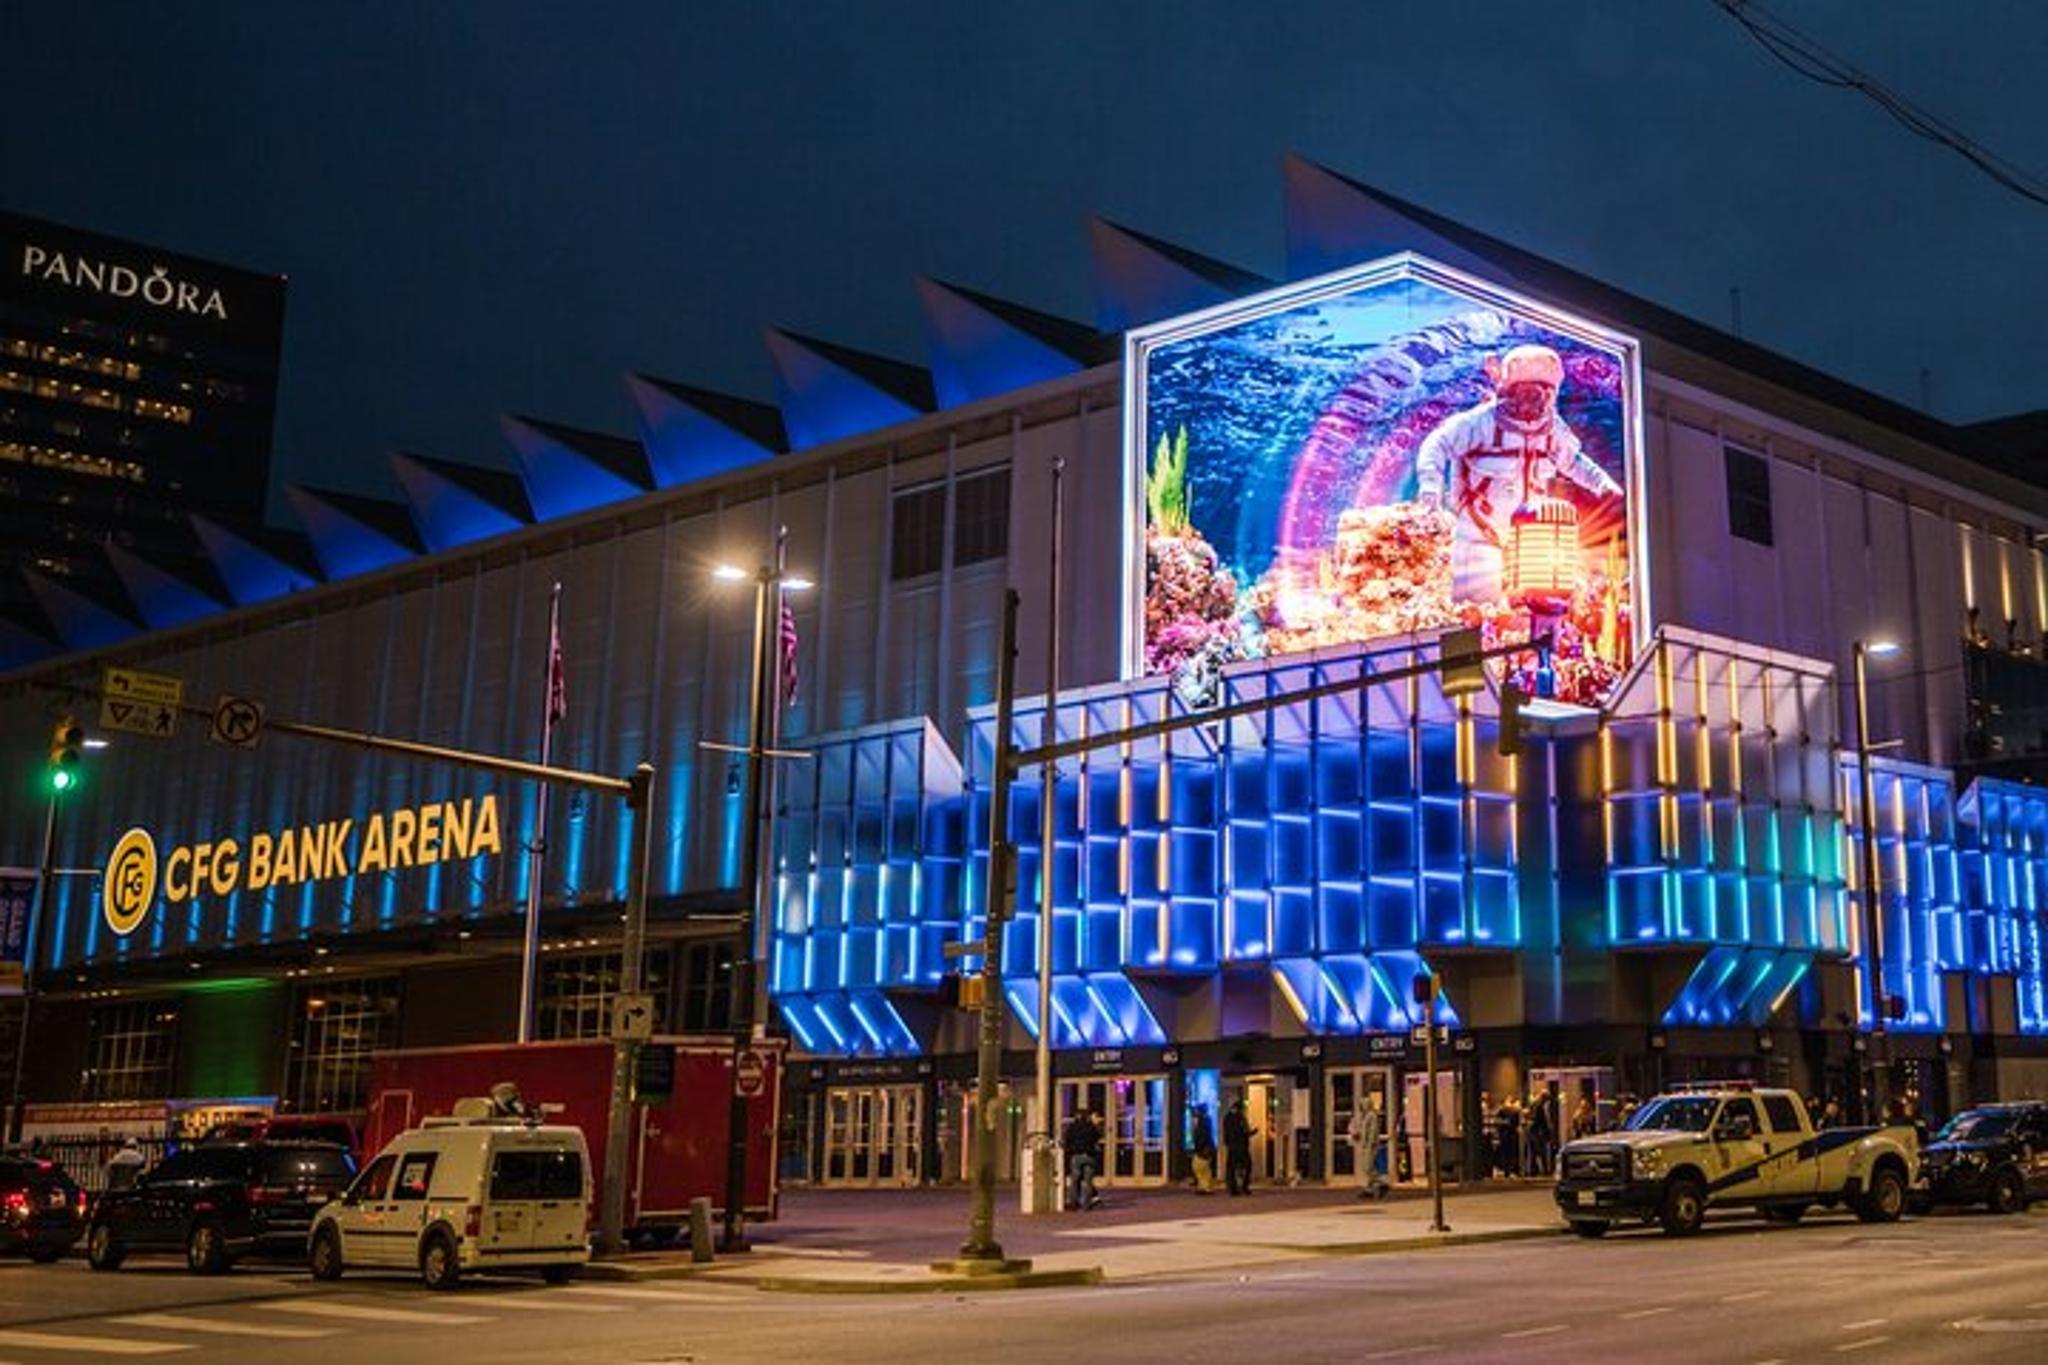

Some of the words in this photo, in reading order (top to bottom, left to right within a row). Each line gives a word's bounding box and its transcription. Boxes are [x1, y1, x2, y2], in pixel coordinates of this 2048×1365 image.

[22, 245, 228, 320] PANDORA
[164, 838, 240, 903] CFG
[248, 818, 354, 891] BANK
[358, 794, 502, 874] ARENA
